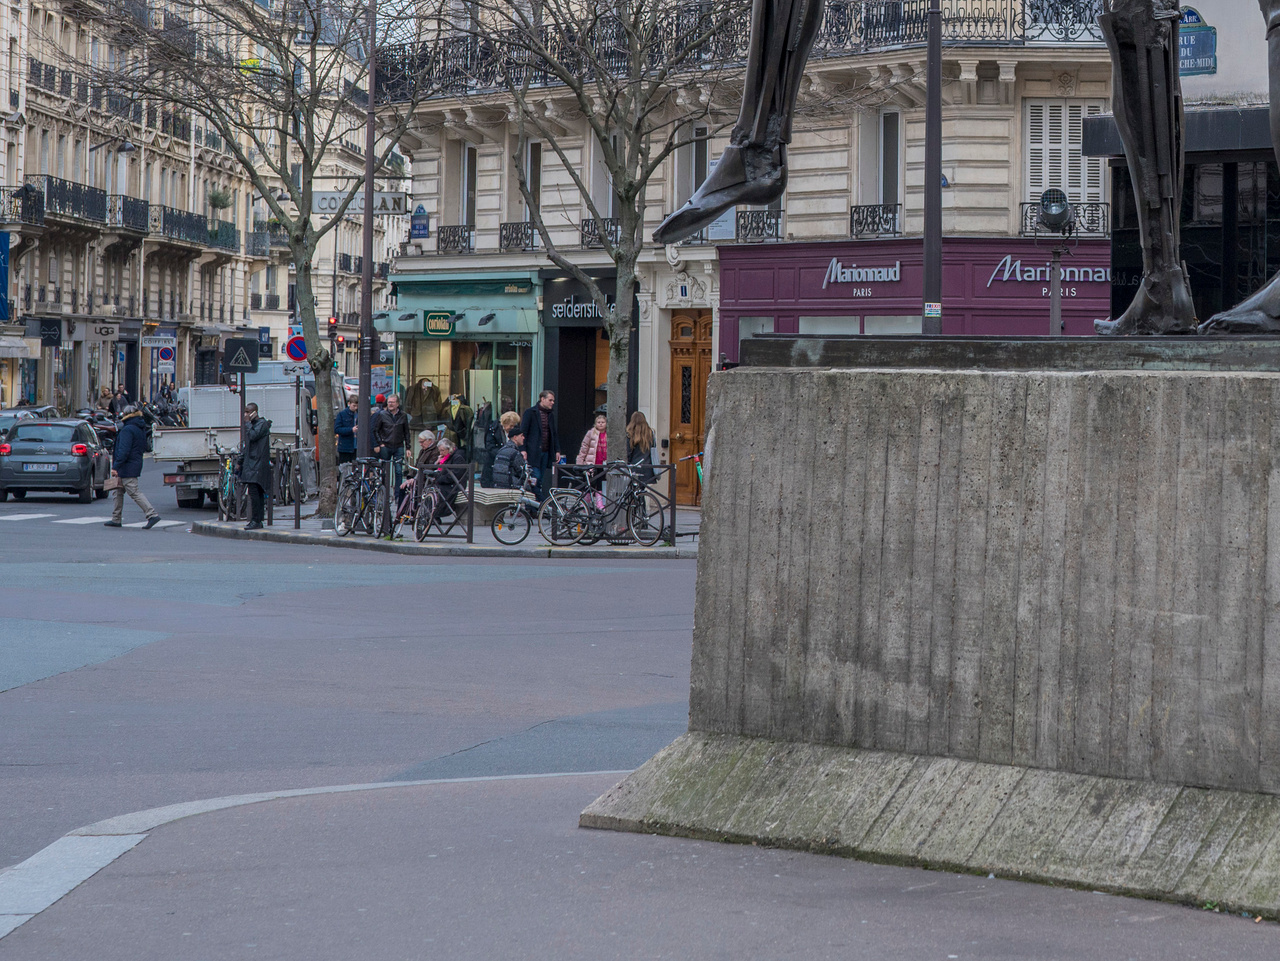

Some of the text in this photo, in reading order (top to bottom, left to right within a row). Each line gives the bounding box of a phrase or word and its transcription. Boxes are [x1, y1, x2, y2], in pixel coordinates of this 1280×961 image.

[1179, 36, 1195, 44] RUE
[1181, 48, 1193, 57] DU
[1179, 58, 1214, 68] CHE-MIDI
[318, 197, 402, 211] COIOAN
[822, 257, 901, 289] Marionnaud
[987, 255, 1111, 288] Marinna
[853, 288, 872, 297] PARIS
[1042, 287, 1077, 297] PRIS
[428, 317, 450, 331] coriolan
[94, 326, 115, 336] UGG
